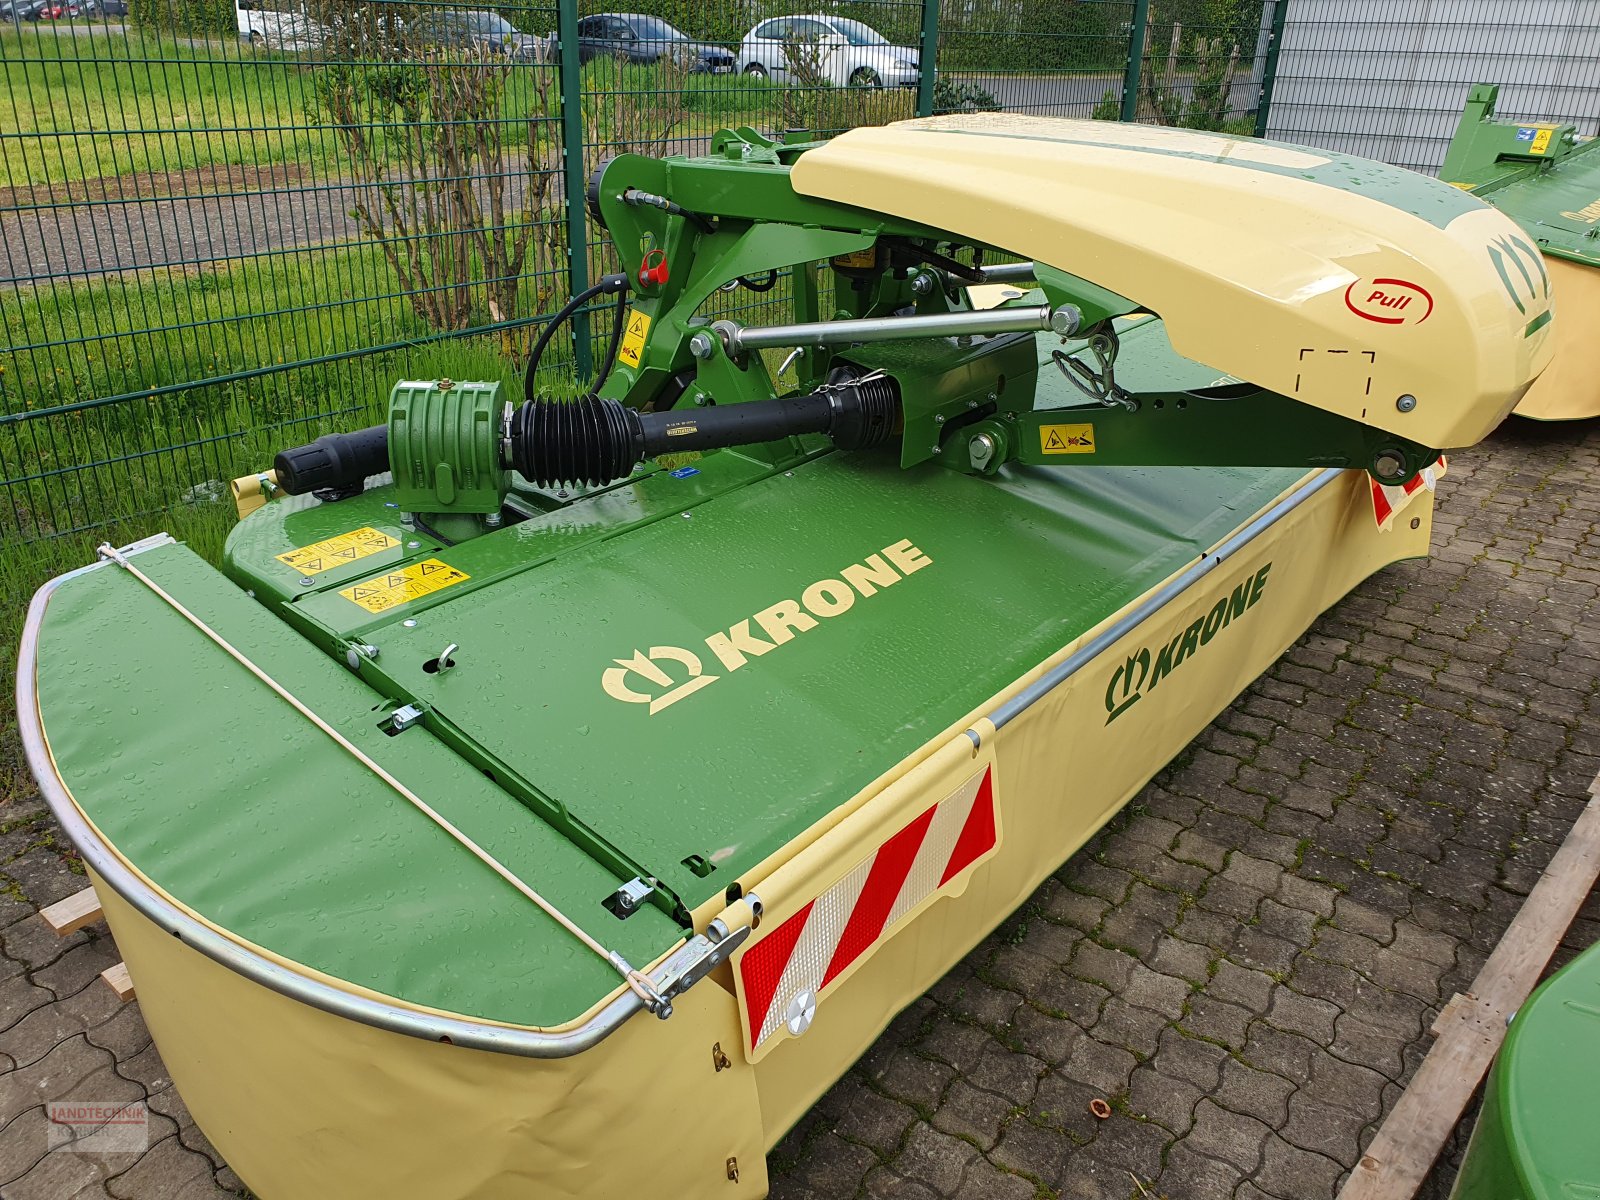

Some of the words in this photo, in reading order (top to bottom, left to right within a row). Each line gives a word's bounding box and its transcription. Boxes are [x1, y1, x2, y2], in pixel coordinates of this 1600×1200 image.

[1366, 290, 1412, 310] Pull
[704, 538, 933, 673] KRONE
[1147, 561, 1272, 693] KRONE
